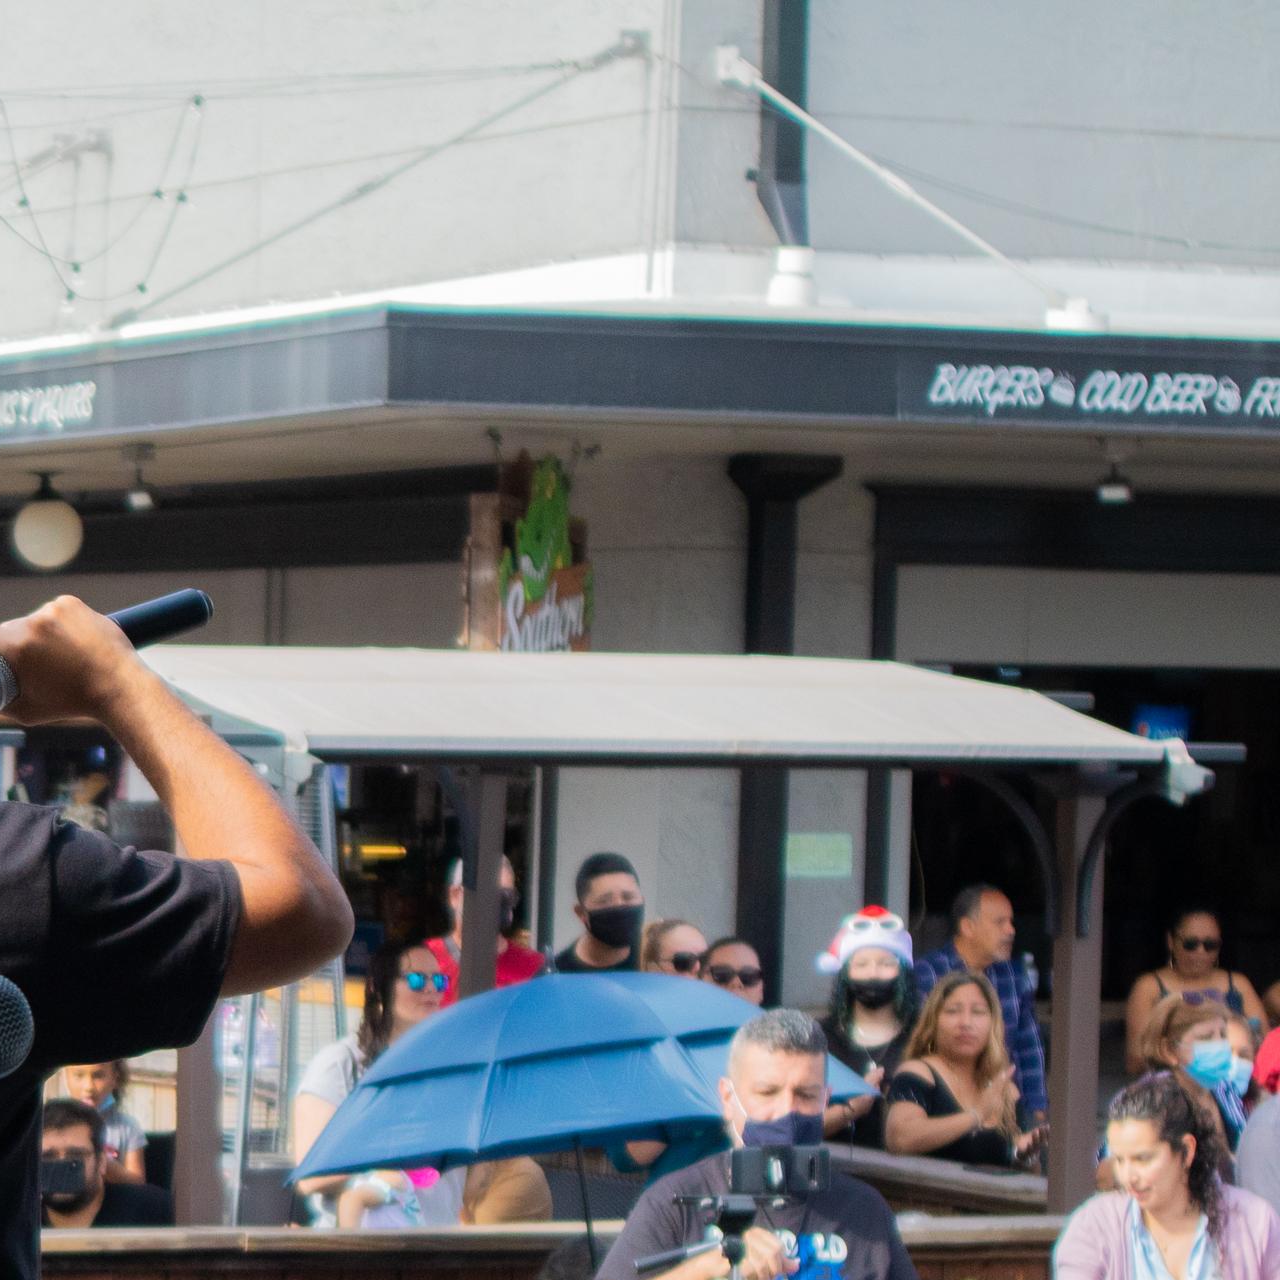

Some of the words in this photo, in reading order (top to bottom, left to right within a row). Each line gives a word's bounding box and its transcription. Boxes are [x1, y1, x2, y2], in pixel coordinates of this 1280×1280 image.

[929, 363, 1054, 415] BURGERS
[1080, 370, 1148, 413] COLD
[1144, 372, 1217, 415] BEER
